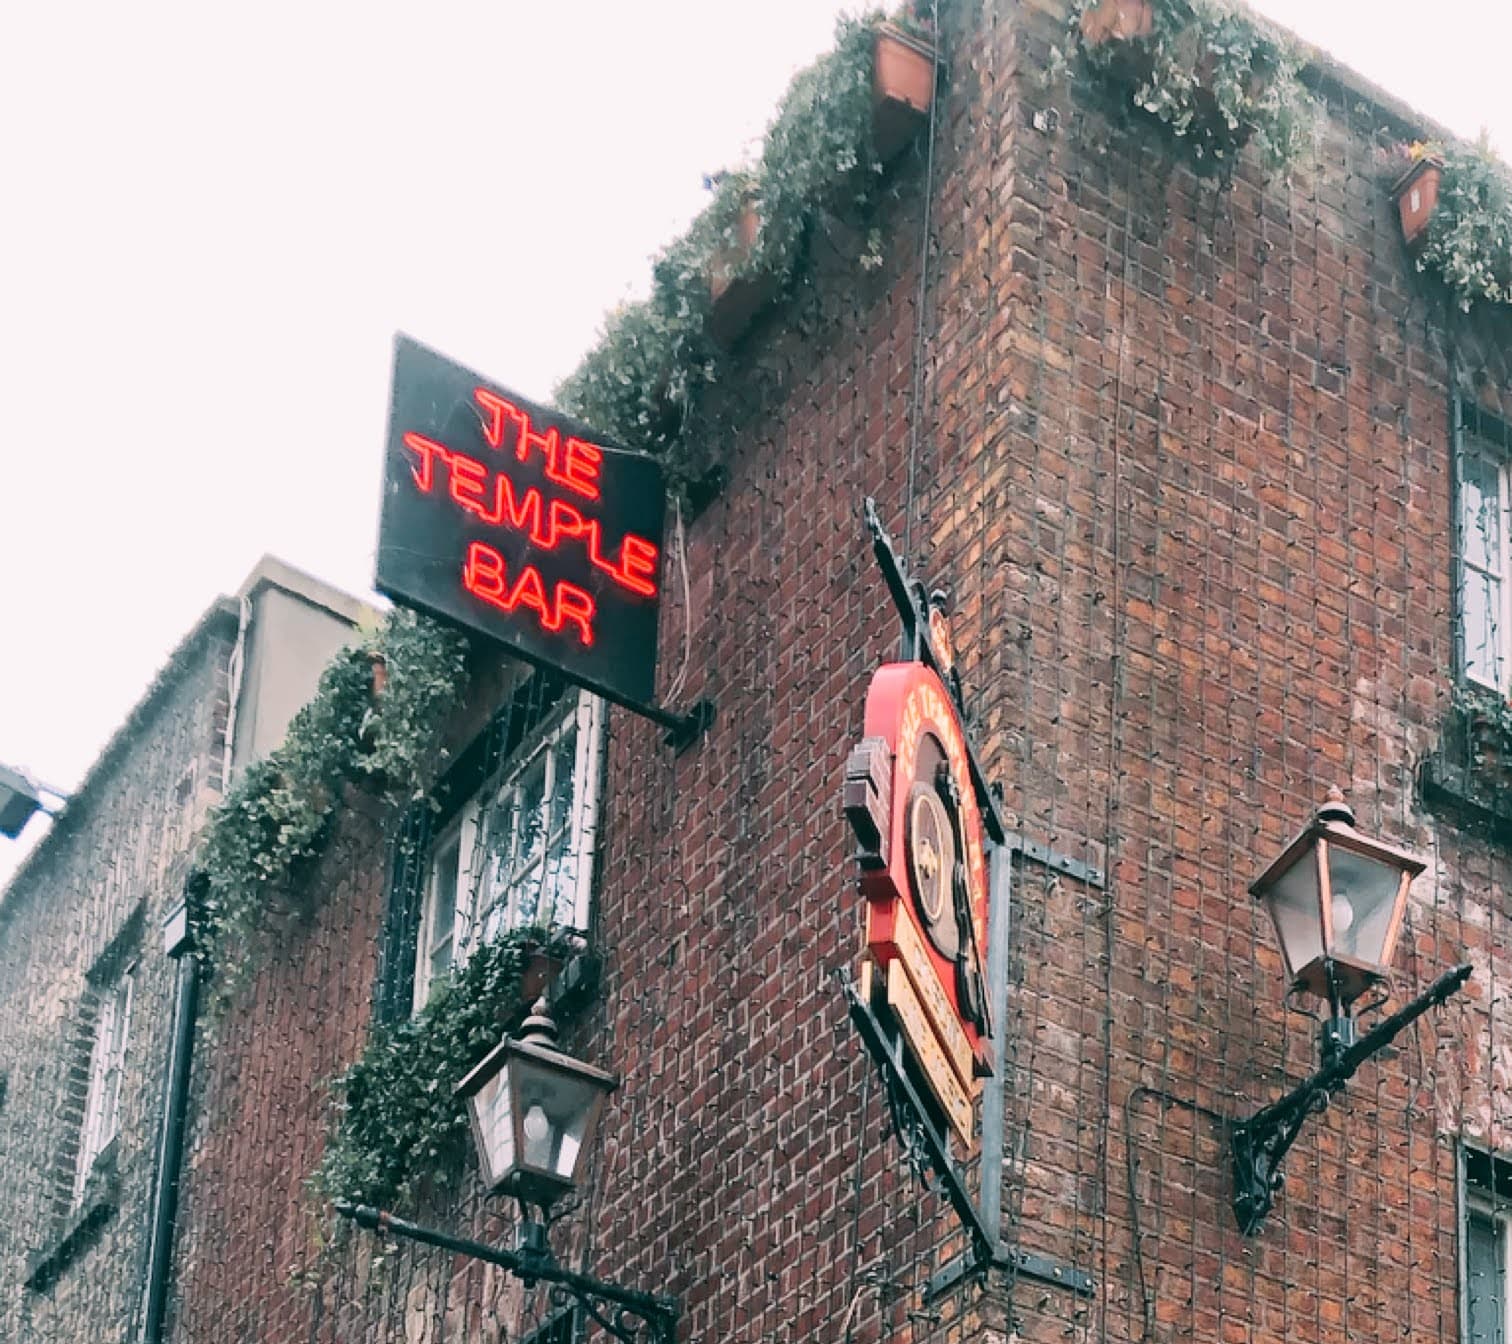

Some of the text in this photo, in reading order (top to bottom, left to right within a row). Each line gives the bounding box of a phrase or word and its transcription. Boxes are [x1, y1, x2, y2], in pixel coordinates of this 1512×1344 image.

[472, 386, 603, 500] THE
[402, 431, 660, 597] TEMPLE
[464, 541, 596, 645] BAR
